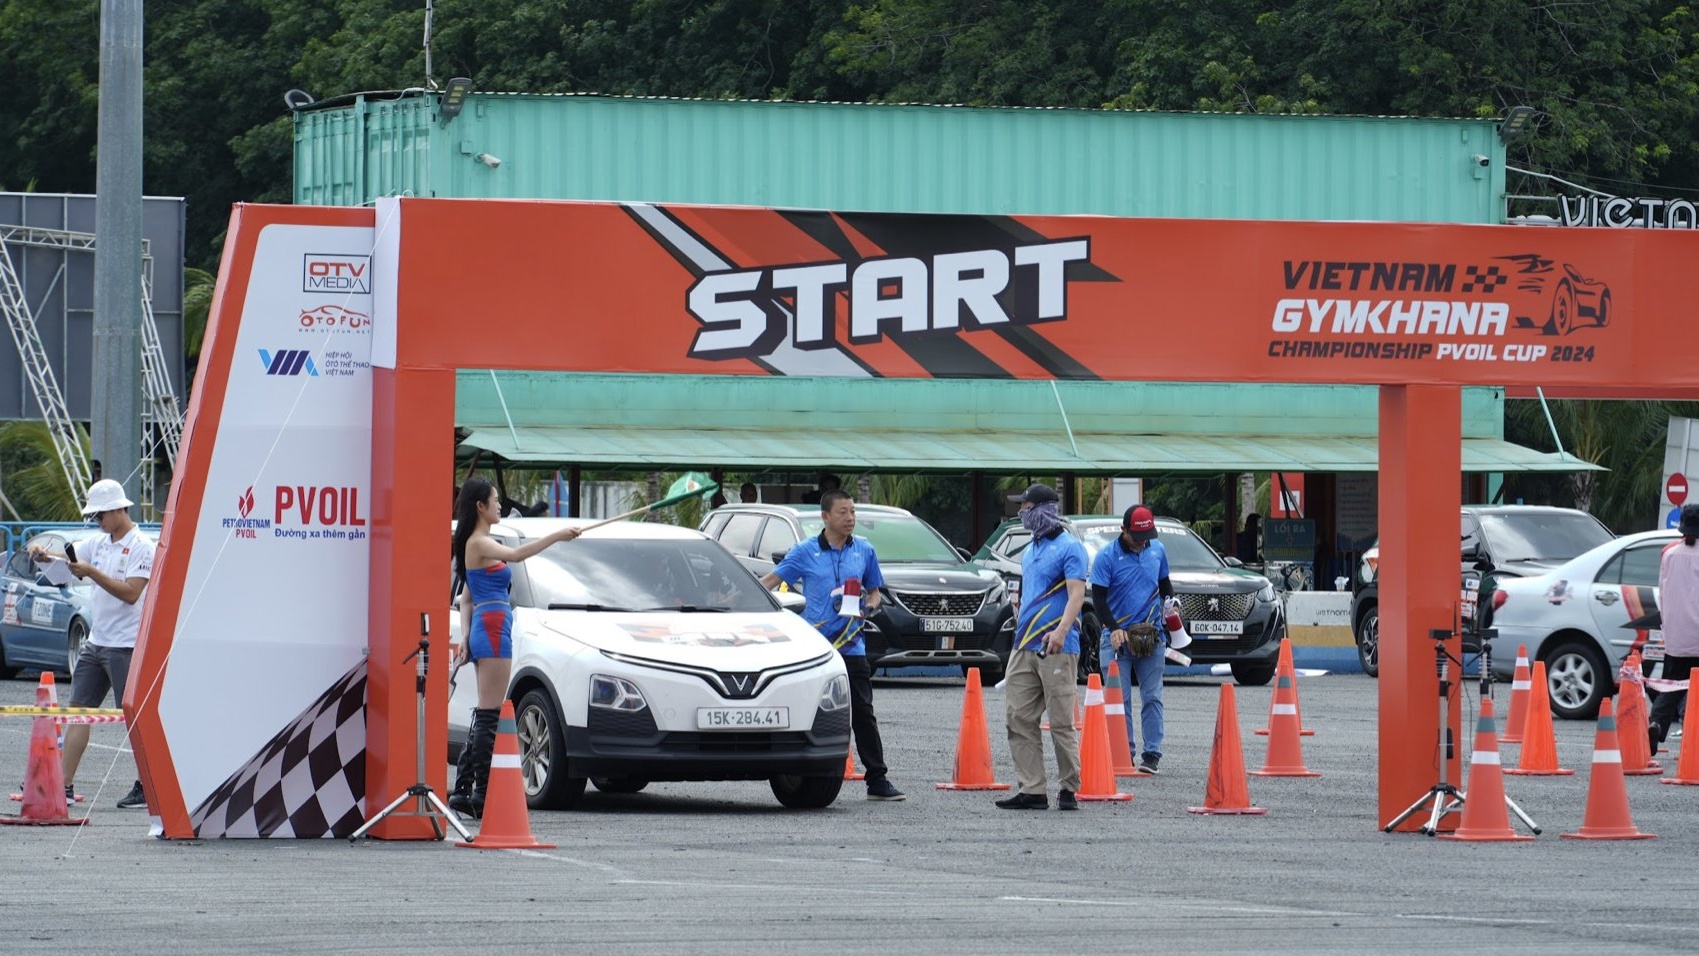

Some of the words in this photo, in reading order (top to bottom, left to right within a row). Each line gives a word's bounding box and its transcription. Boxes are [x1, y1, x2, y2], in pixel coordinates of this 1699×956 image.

[309, 262, 365, 277] OTV
[1283, 260, 1457, 293] VIETNAM
[309, 277, 366, 293] MEDIA
[687, 239, 1090, 354] START
[301, 315, 370, 328] OTOFUN
[1272, 298, 1510, 336] GYMKHANA
[1268, 340, 1433, 360] CHAMPIONSHIP
[1436, 343, 1498, 361] PVOIL
[1502, 345, 1548, 362] CUP
[1550, 346, 1595, 362] 2024
[275, 486, 365, 526] PVOIL
[235, 529, 257, 539] PVOIL
[275, 528, 307, 540] Đường
[309, 530, 320, 539] xa
[322, 529, 346, 539] thêm
[348, 528, 366, 541] gần
[1292, 524, 1306, 534] RA
[1194, 624, 1240, 633] 60K-047.14
[706, 710, 781, 726] 15K-284.41
